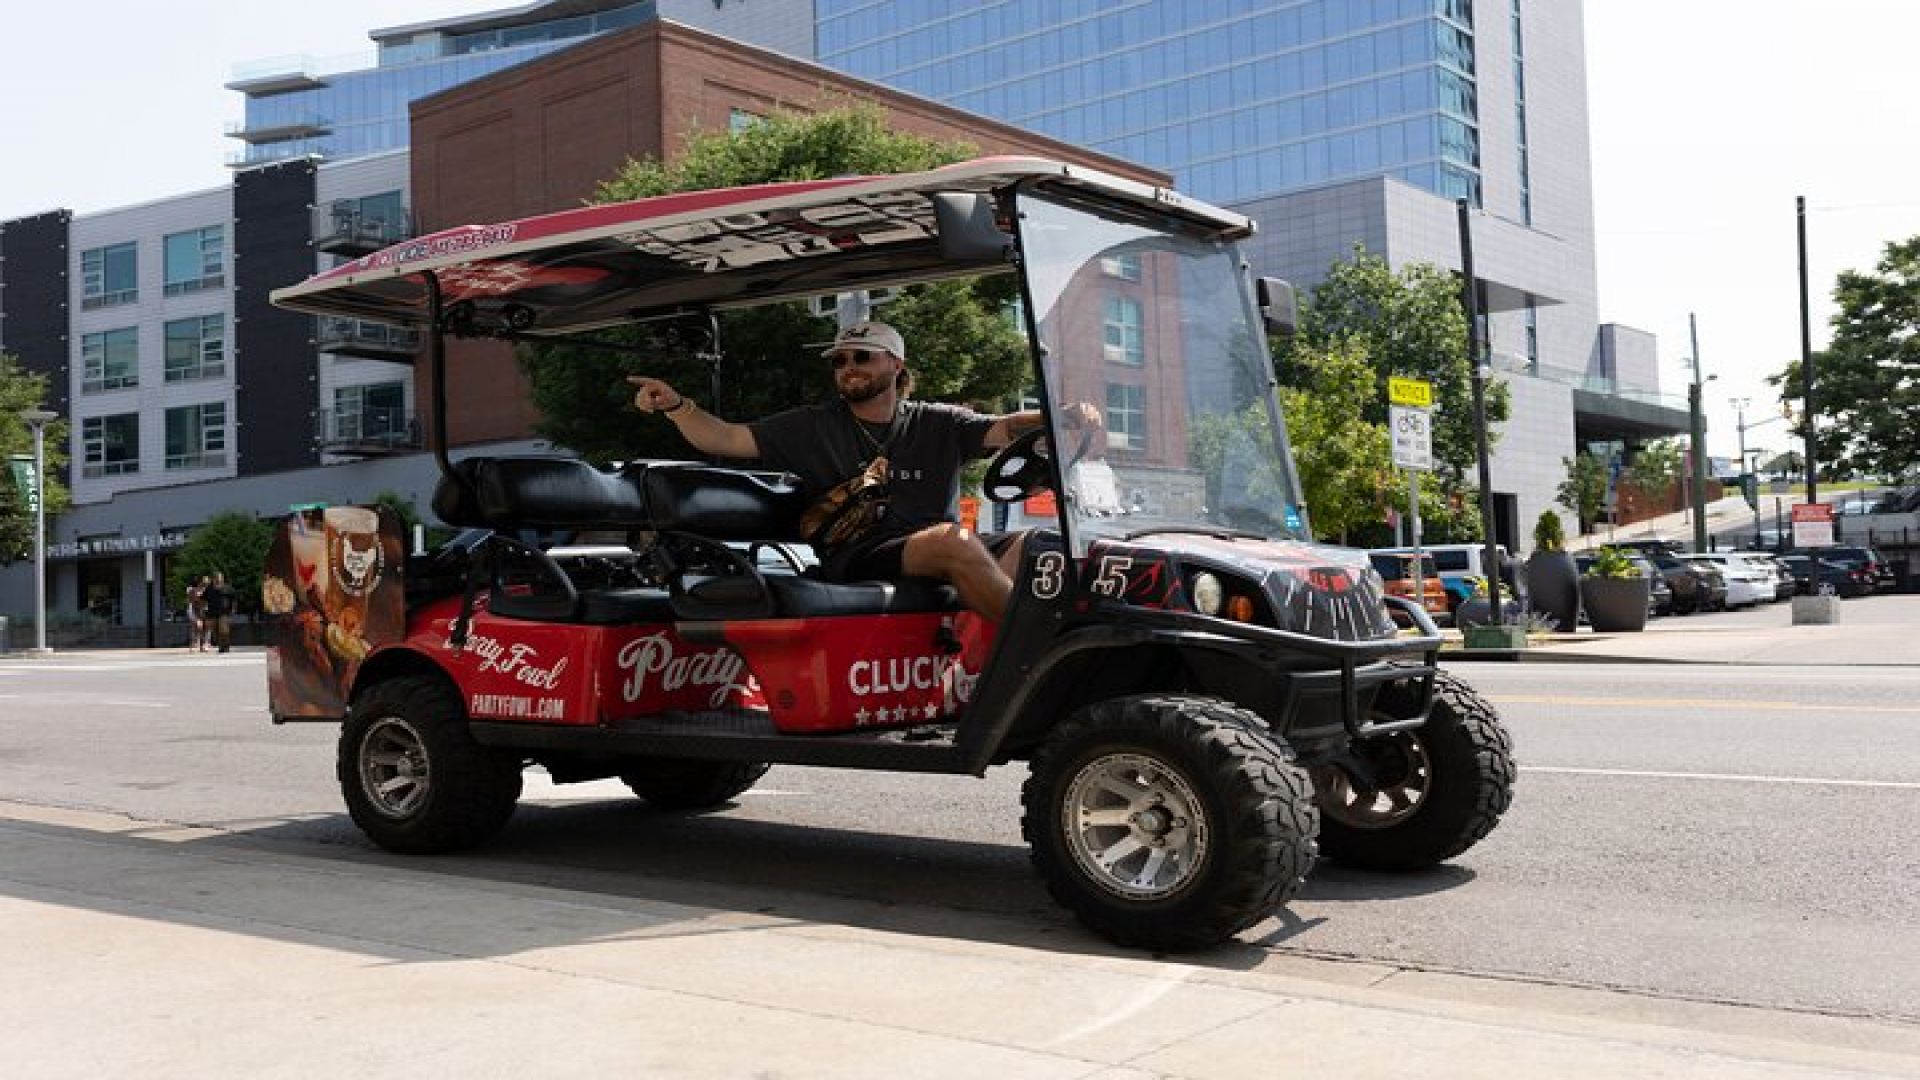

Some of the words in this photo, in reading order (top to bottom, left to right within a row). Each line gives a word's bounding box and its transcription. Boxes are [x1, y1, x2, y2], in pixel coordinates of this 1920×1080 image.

[443, 617, 505, 672] arty
[618, 630, 745, 707] Party
[471, 694, 564, 719] PARTYFOWL.COM
